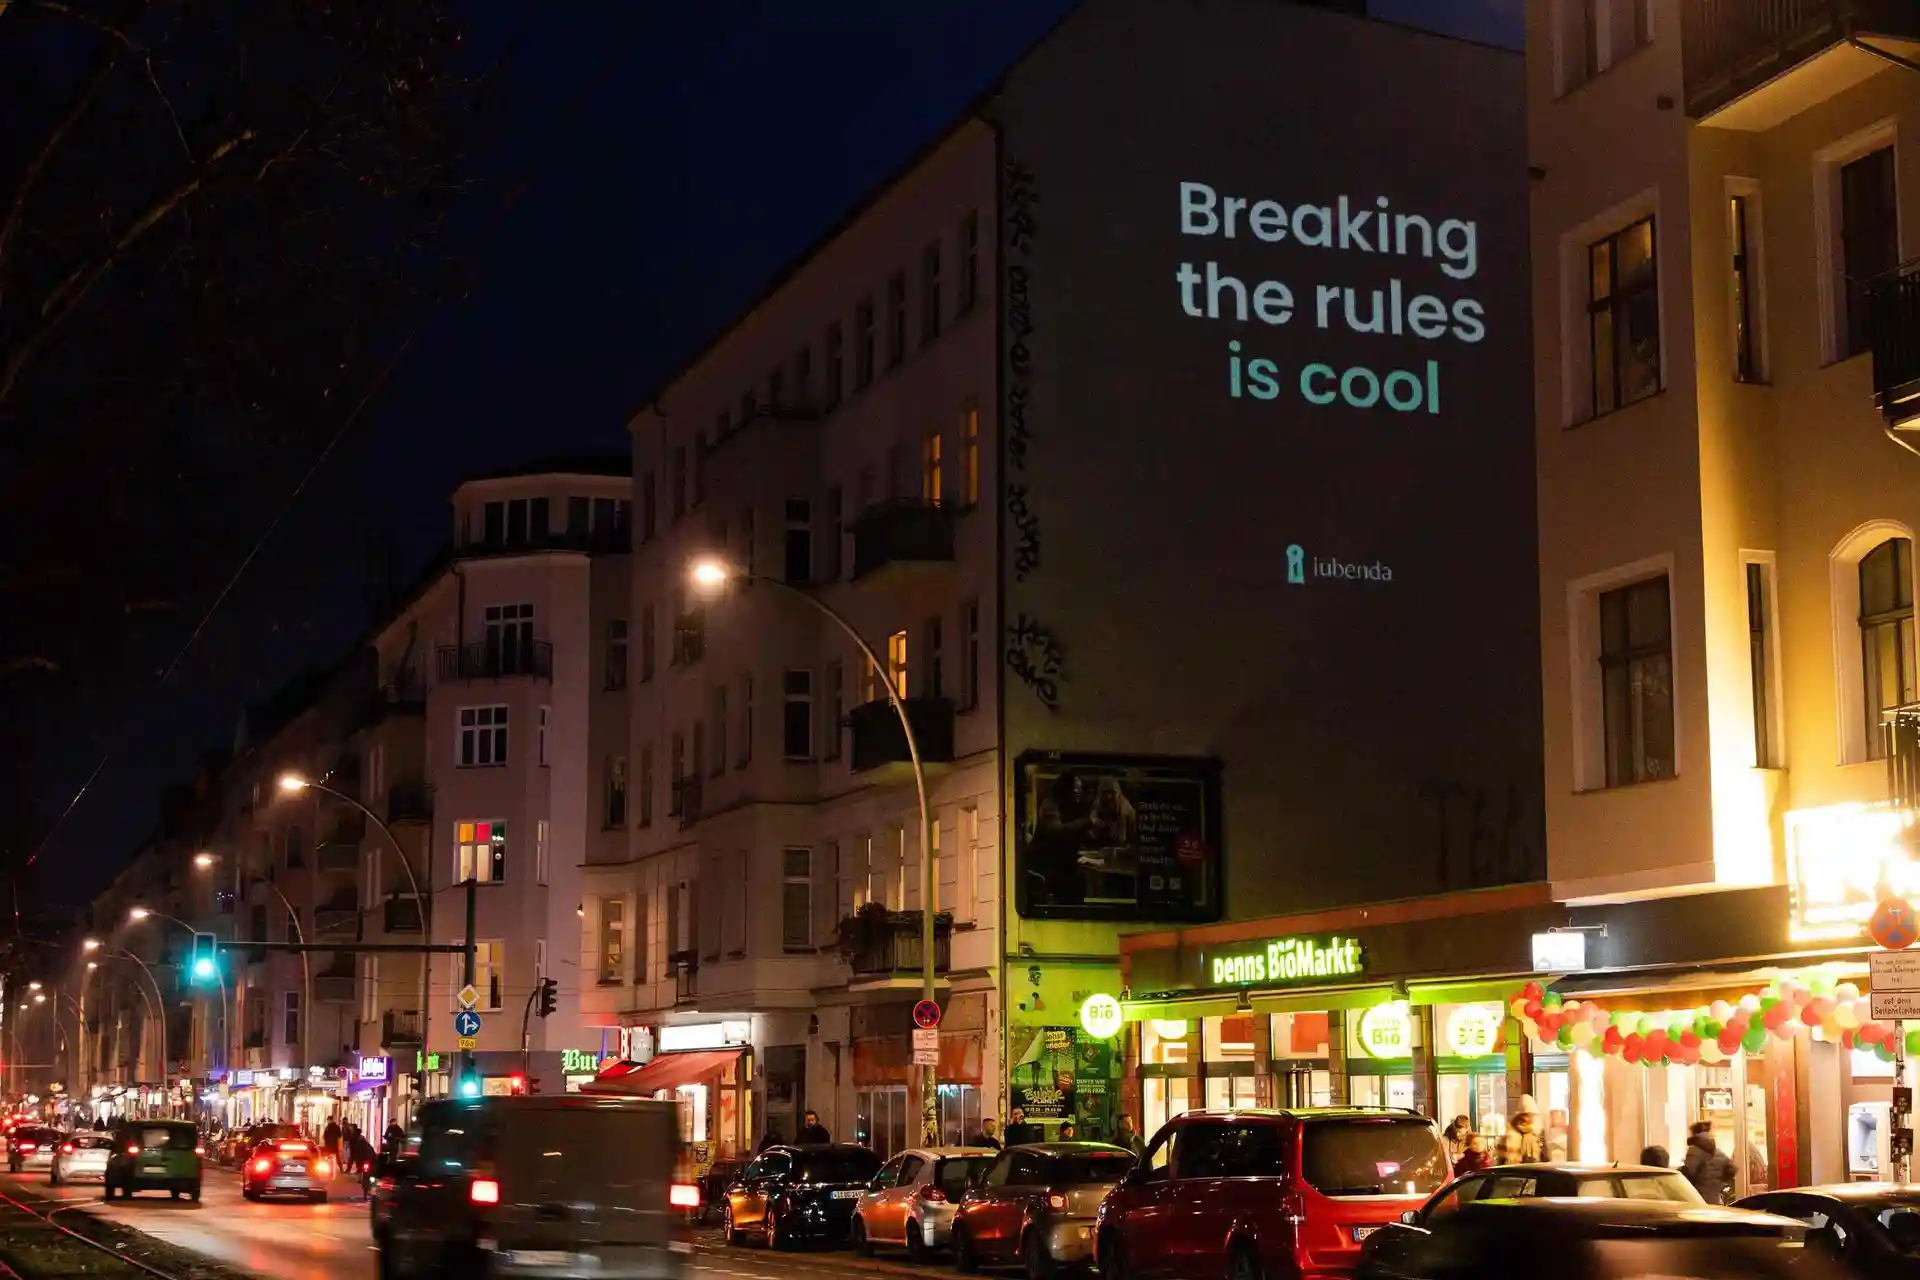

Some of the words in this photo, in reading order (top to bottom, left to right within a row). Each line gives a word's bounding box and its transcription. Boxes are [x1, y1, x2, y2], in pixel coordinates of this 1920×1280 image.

[1180, 181, 1478, 279] Breaking
[1176, 261, 1295, 325] the
[1316, 278, 1486, 343] rules
[1229, 339, 1280, 400] is
[1300, 359, 1440, 415] cool
[1313, 556, 1393, 581] iubenda
[1090, 1003, 1113, 1018] Bio
[1372, 1026, 1400, 1045] Bio
